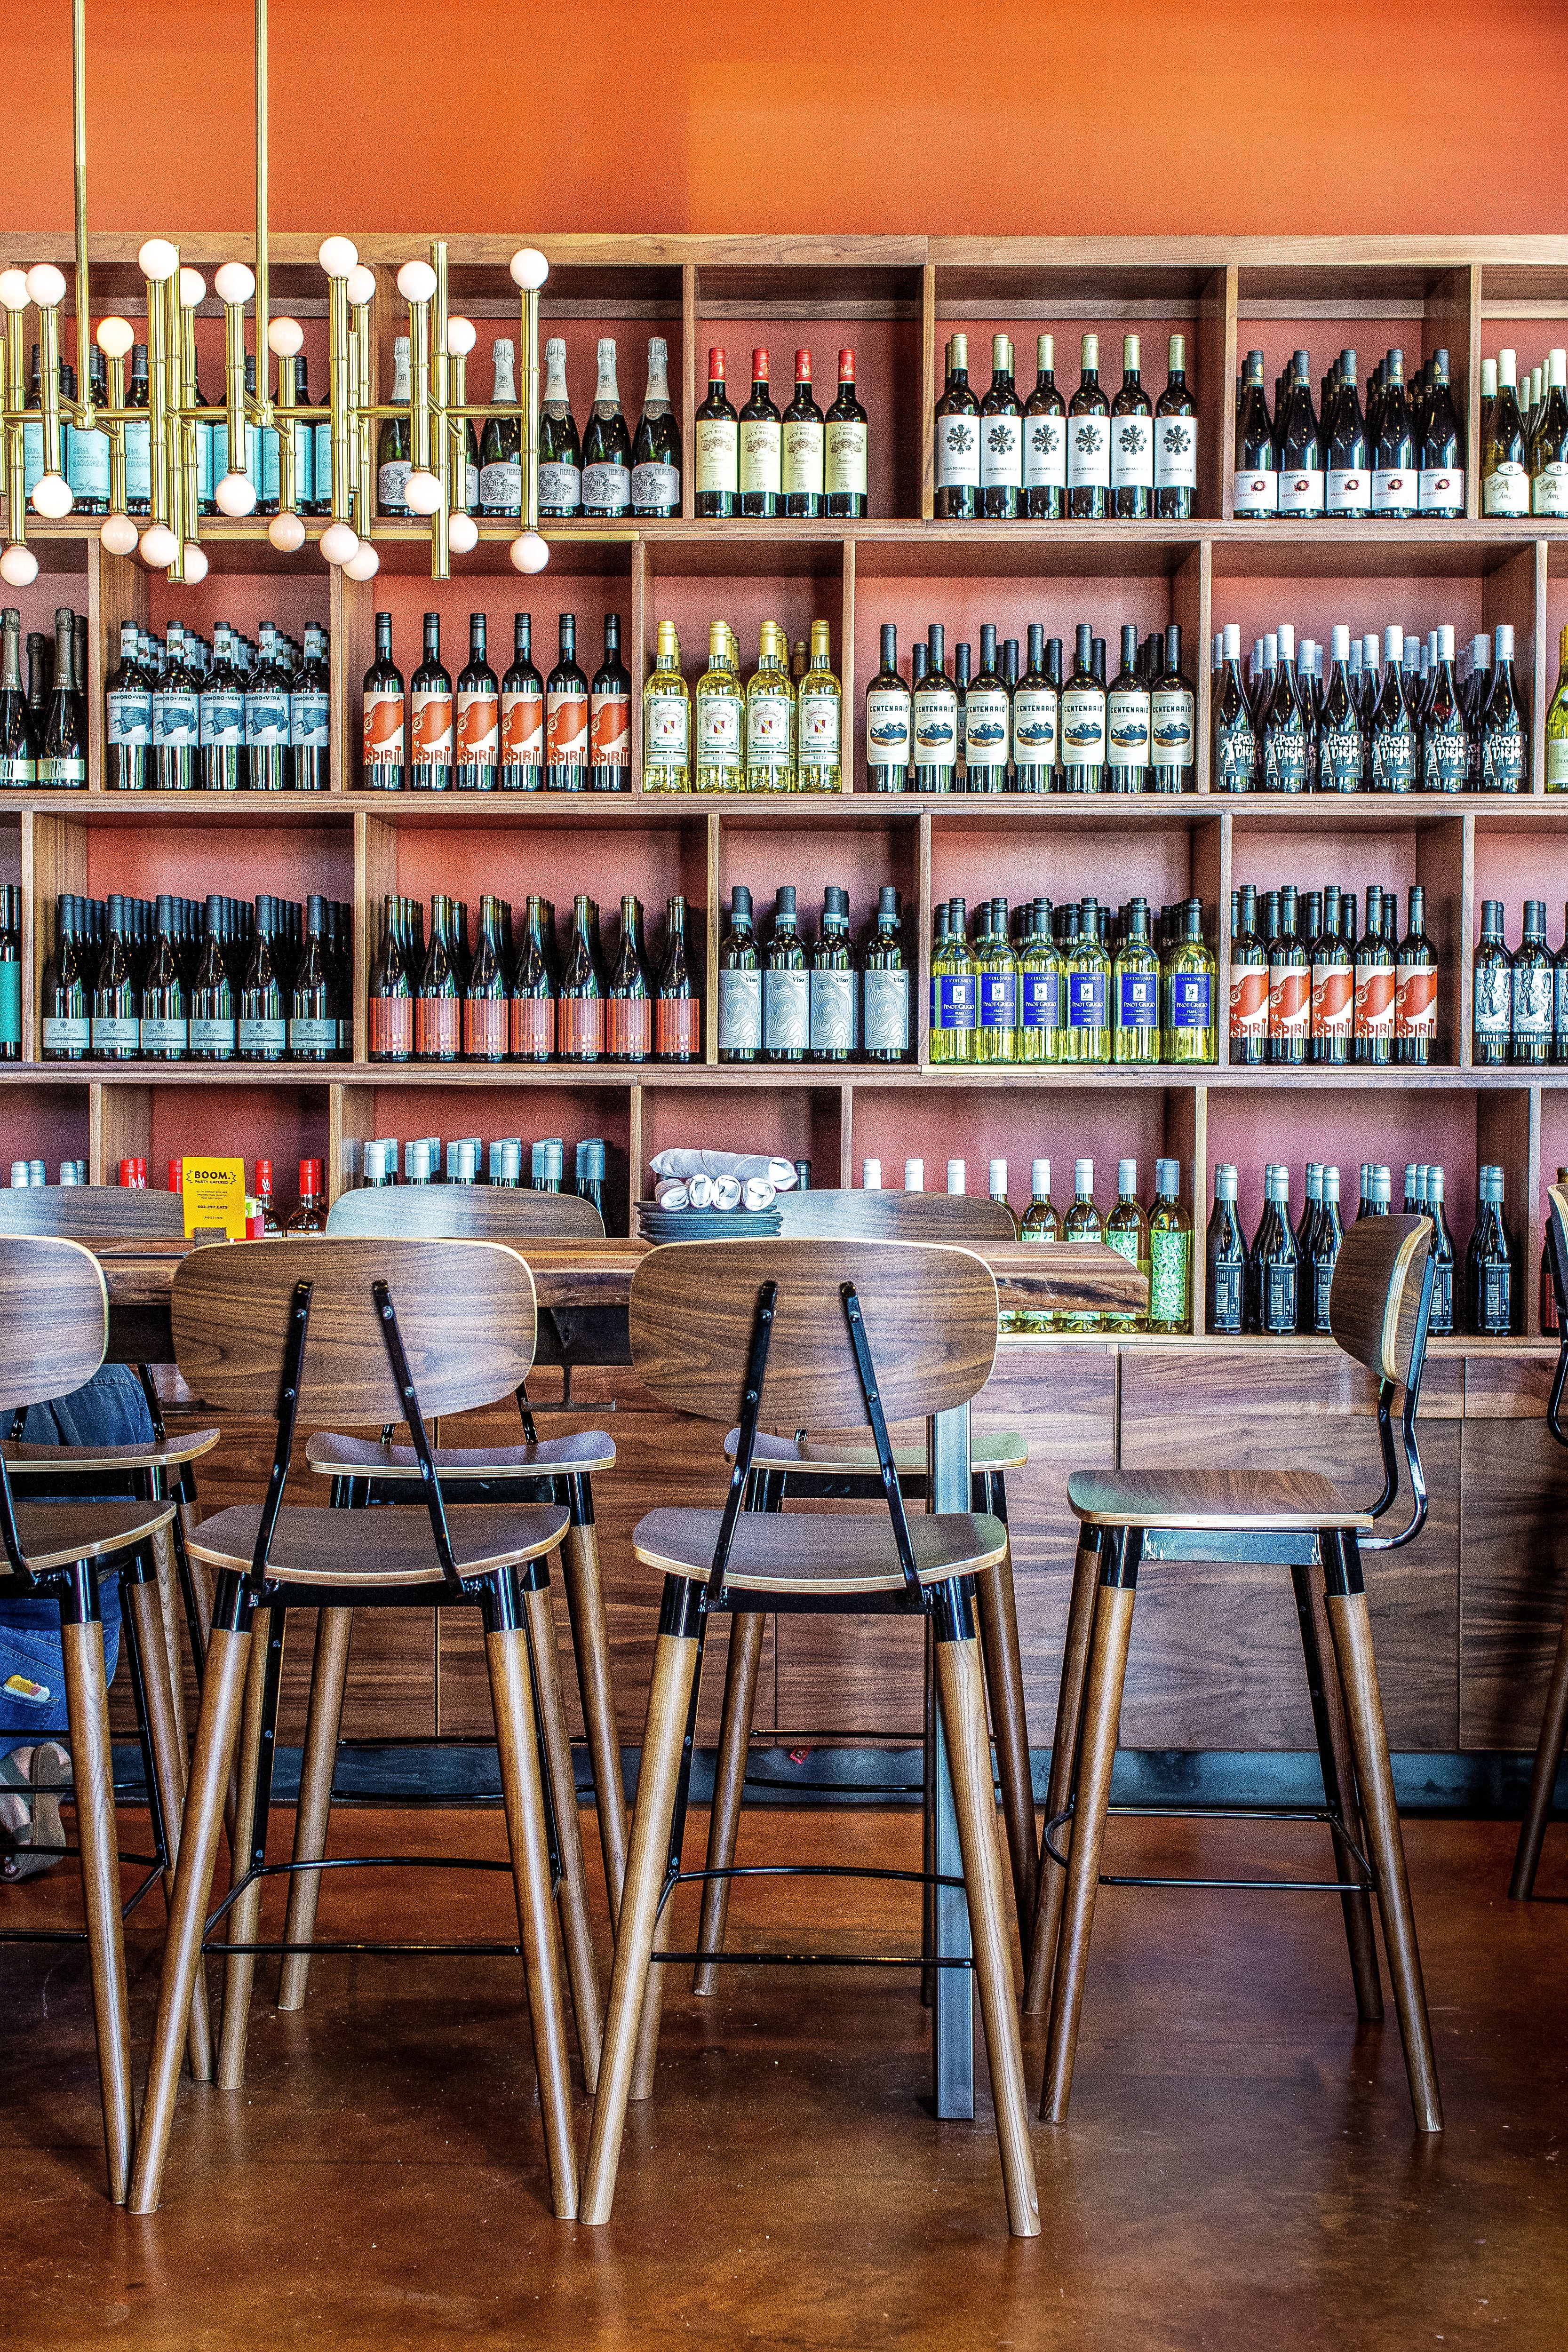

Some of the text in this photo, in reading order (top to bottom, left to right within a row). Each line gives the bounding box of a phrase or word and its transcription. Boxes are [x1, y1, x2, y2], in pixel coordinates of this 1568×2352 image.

[700, 430, 713, 439] HAUT
[745, 431, 757, 440] HAUT
[787, 432, 798, 441] HAUT
[829, 432, 841, 441] HAUT
[1276, 734, 1304, 747] País
[1330, 733, 1358, 746] País
[1381, 734, 1409, 747] País
[1437, 735, 1465, 747] País
[1492, 735, 1521, 747] País
[1276, 746, 1305, 765] Viejo
[1330, 746, 1359, 764] Viejo
[1382, 747, 1411, 765] Viejo
[1437, 747, 1465, 765] Viejo
[1492, 747, 1522, 765] Viejo
[195, 1171, 231, 1180] BOOM.
[1217, 1282, 1229, 1313] STAGEDIVE
[1271, 1283, 1283, 1315] STAGEDIVE
[1319, 1283, 1329, 1315] STAGEDIVE
[1488, 1283, 1499, 1315] STAGEDIVE
